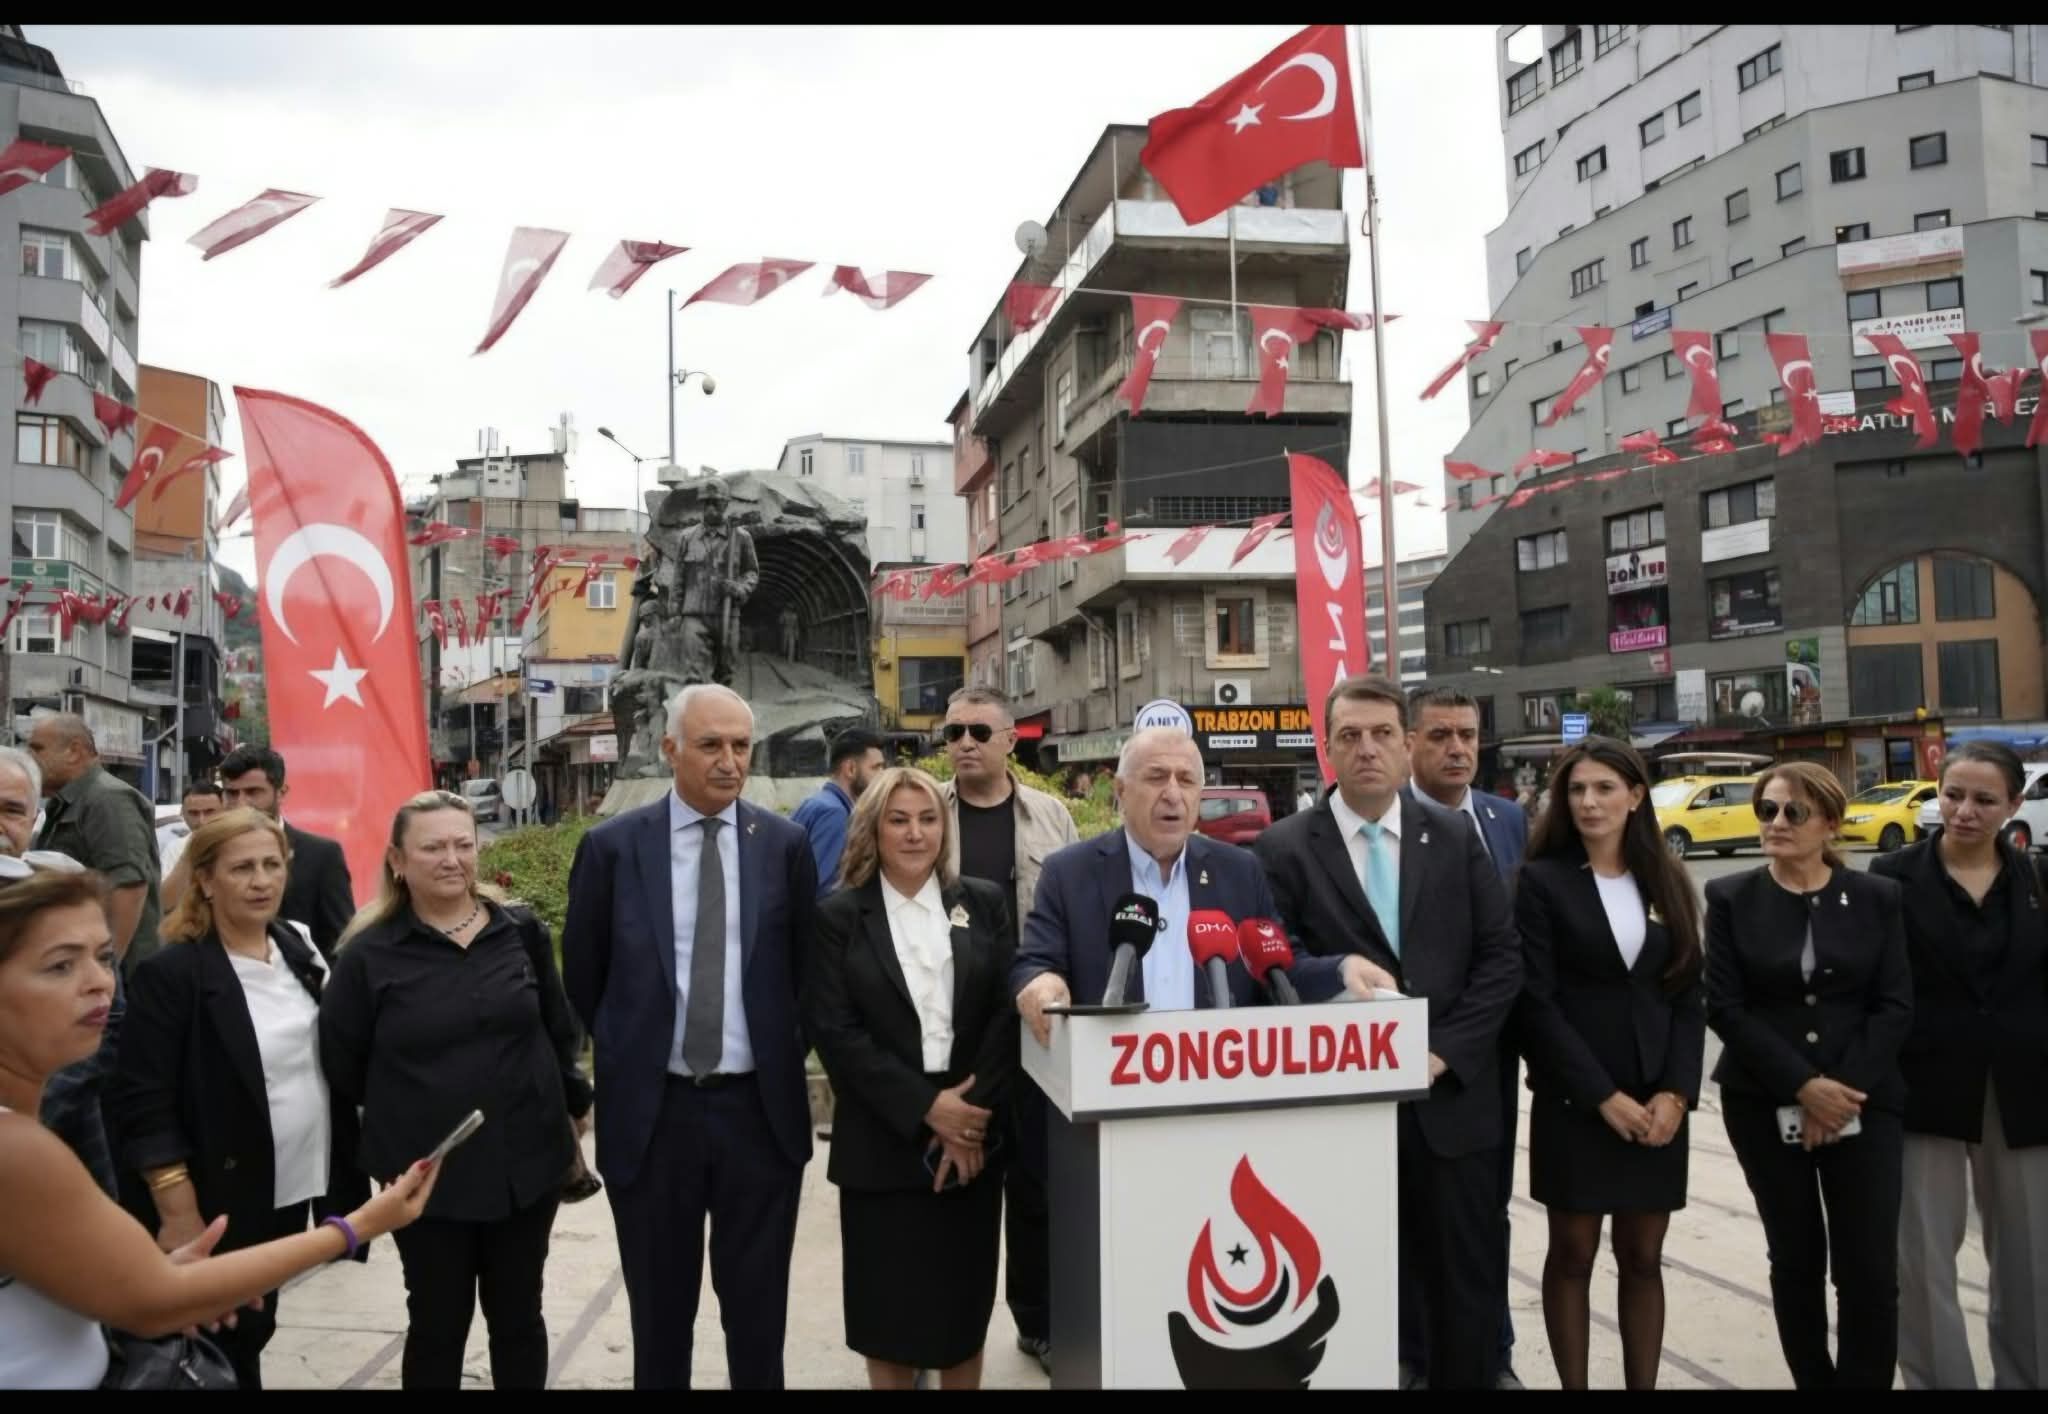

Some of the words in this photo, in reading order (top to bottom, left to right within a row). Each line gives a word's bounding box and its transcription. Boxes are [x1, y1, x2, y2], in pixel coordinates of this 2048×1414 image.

[1193, 708, 1275, 732] TRABZON
[1194, 922, 1233, 935] DHA
[1110, 1021, 1400, 1086] ZONGULDAK
